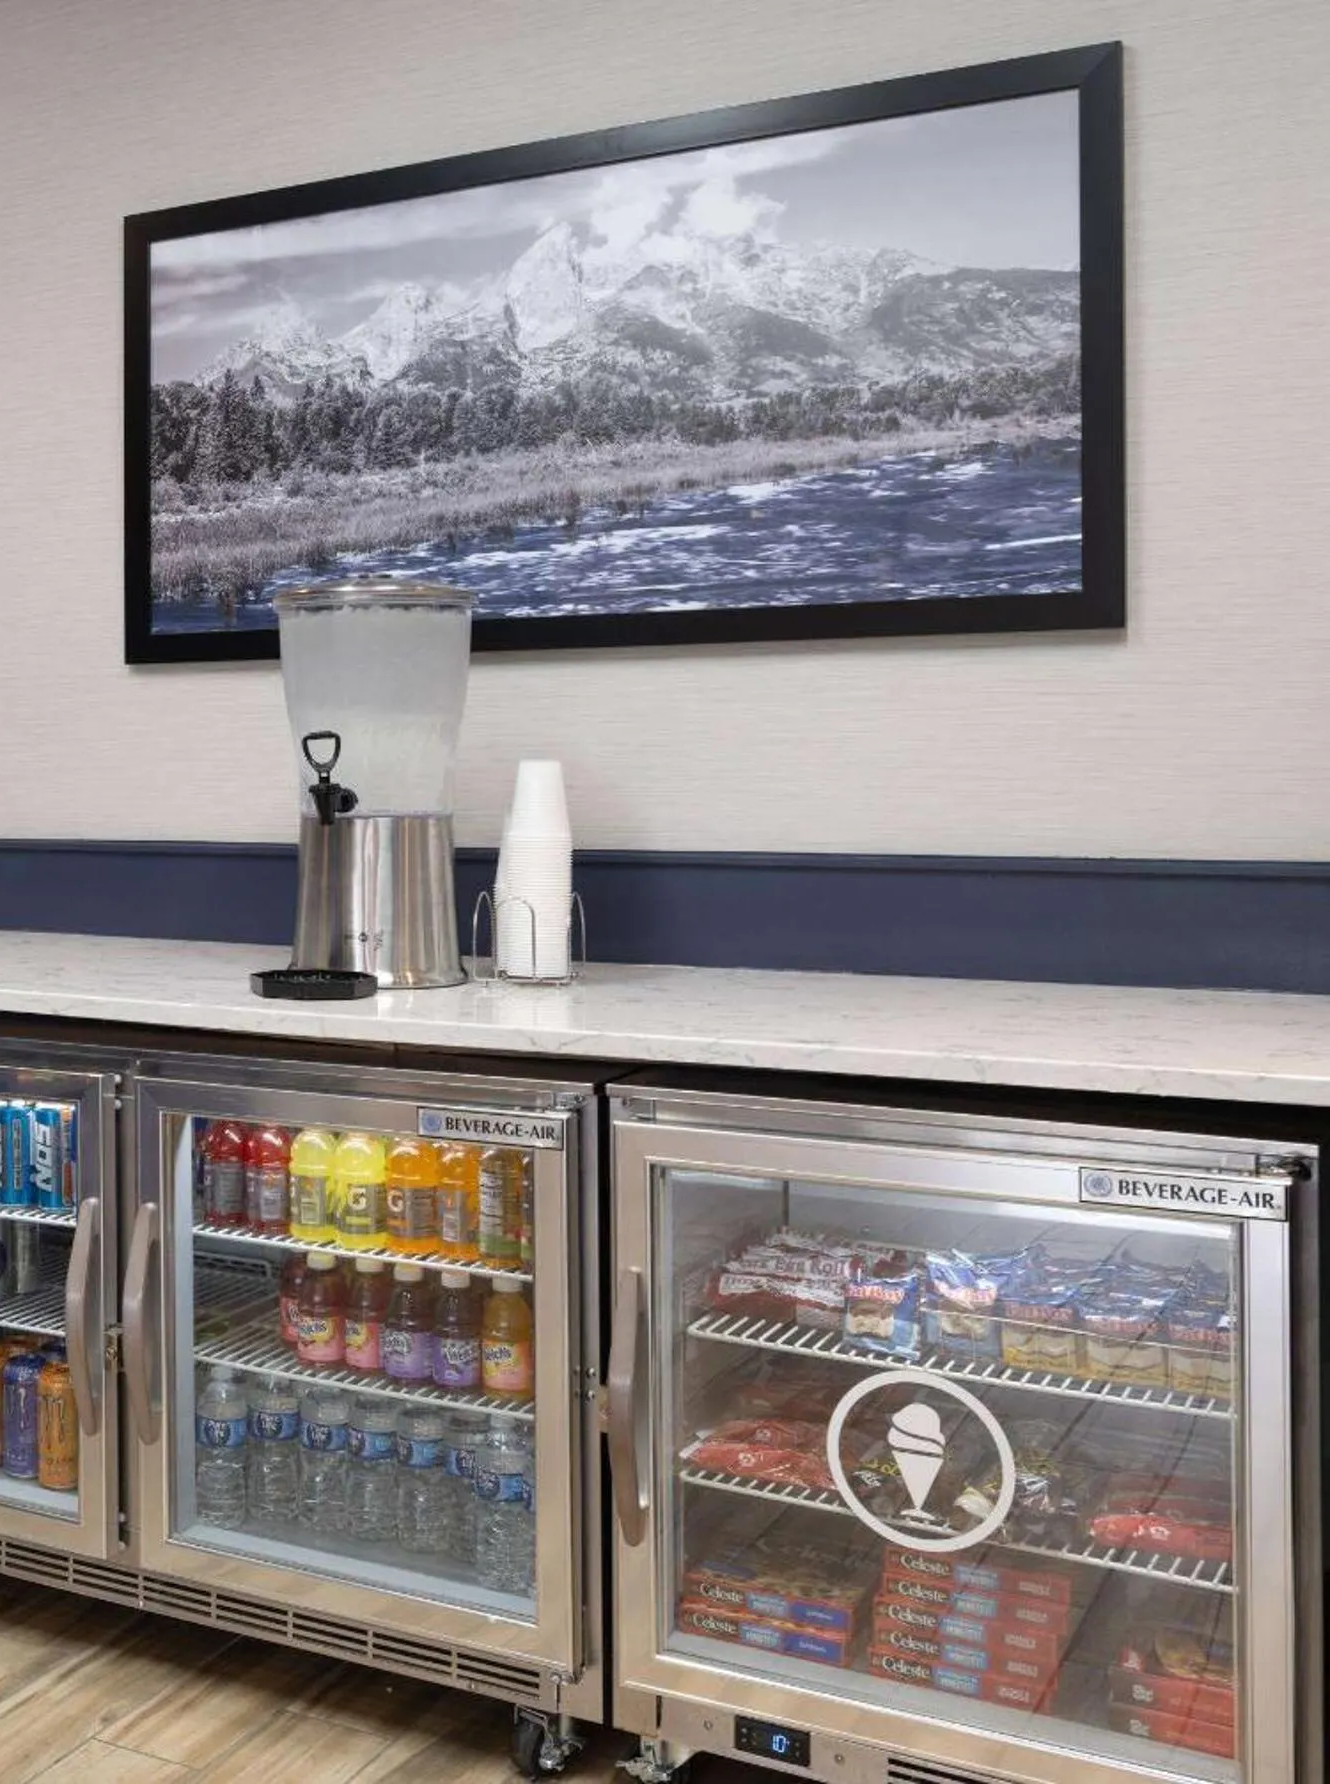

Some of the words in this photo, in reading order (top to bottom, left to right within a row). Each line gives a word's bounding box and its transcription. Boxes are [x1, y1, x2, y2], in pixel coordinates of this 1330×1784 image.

[445, 1116, 556, 1140] BEVERAGE-AIR
[1118, 1178, 1276, 1209] BEVERAGE-AIR
[900, 1553, 951, 1576] Celeste
[699, 1580, 744, 1604] Celeste
[898, 1579, 948, 1603] Celeste
[887, 1602, 937, 1629] Celeste
[889, 1629, 940, 1655] Celeste
[881, 1654, 931, 1680] Celeste
